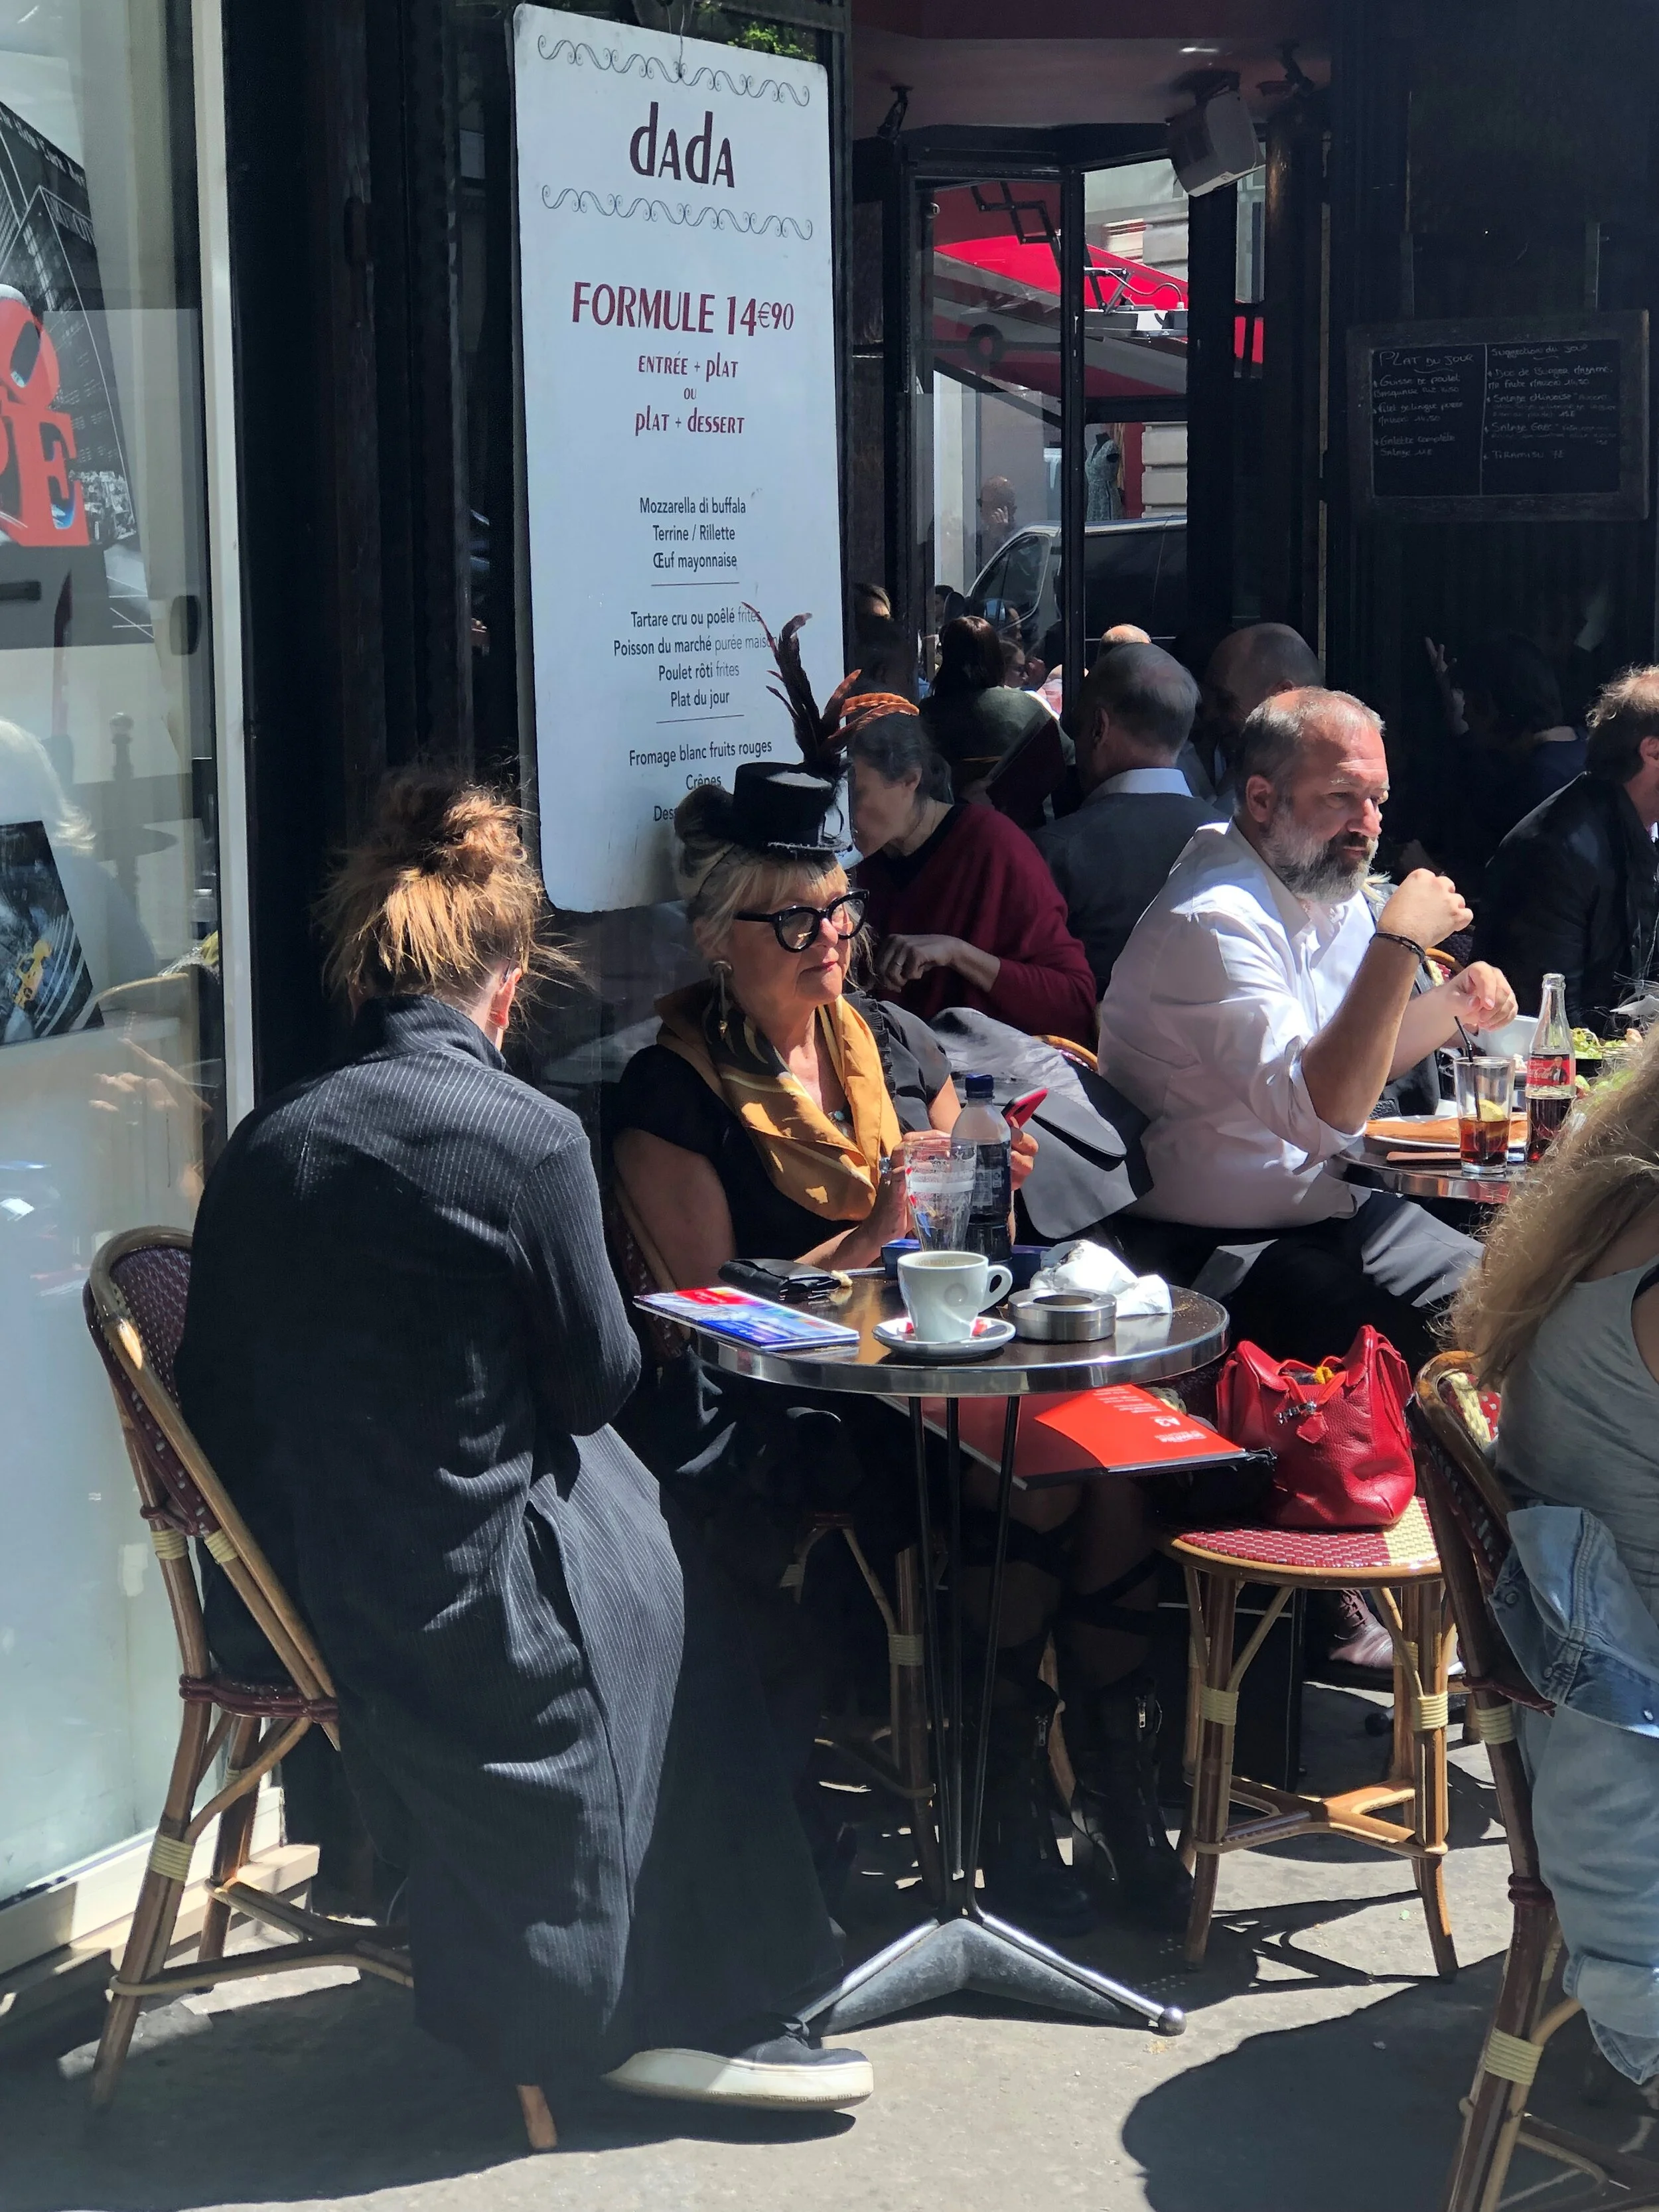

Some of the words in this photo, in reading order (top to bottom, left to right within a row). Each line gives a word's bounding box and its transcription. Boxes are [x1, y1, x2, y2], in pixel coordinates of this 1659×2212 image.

[572, 281, 715, 333] FORMULE
[638, 350, 689, 376] ENTRÉE
[640, 496, 696, 514] Mozzarella
[699, 496, 709, 514] di
[711, 496, 746, 514] buffala
[652, 524, 689, 542] Terrine
[699, 523, 735, 541] Rillette
[678, 552, 737, 573] mayonnaise
[630, 611, 668, 628] Tartare
[672, 614, 687, 626] cru
[691, 613, 703, 625] ou
[707, 607, 735, 629] poêlé
[614, 639, 654, 656] Poisson
[658, 636, 672, 654] du
[674, 634, 712, 653] marché
[715, 634, 743, 656] purée
[658, 663, 693, 682] Poulet
[695, 662, 713, 679] rôti
[715, 660, 740, 677] frites
[670, 690, 691, 707] Plat
[693, 689, 707, 706] du
[709, 688, 730, 709] jour
[629, 749, 676, 768] Fromage
[679, 743, 707, 761] blanc
[709, 741, 736, 758] fruits
[739, 741, 772, 759] rouges
